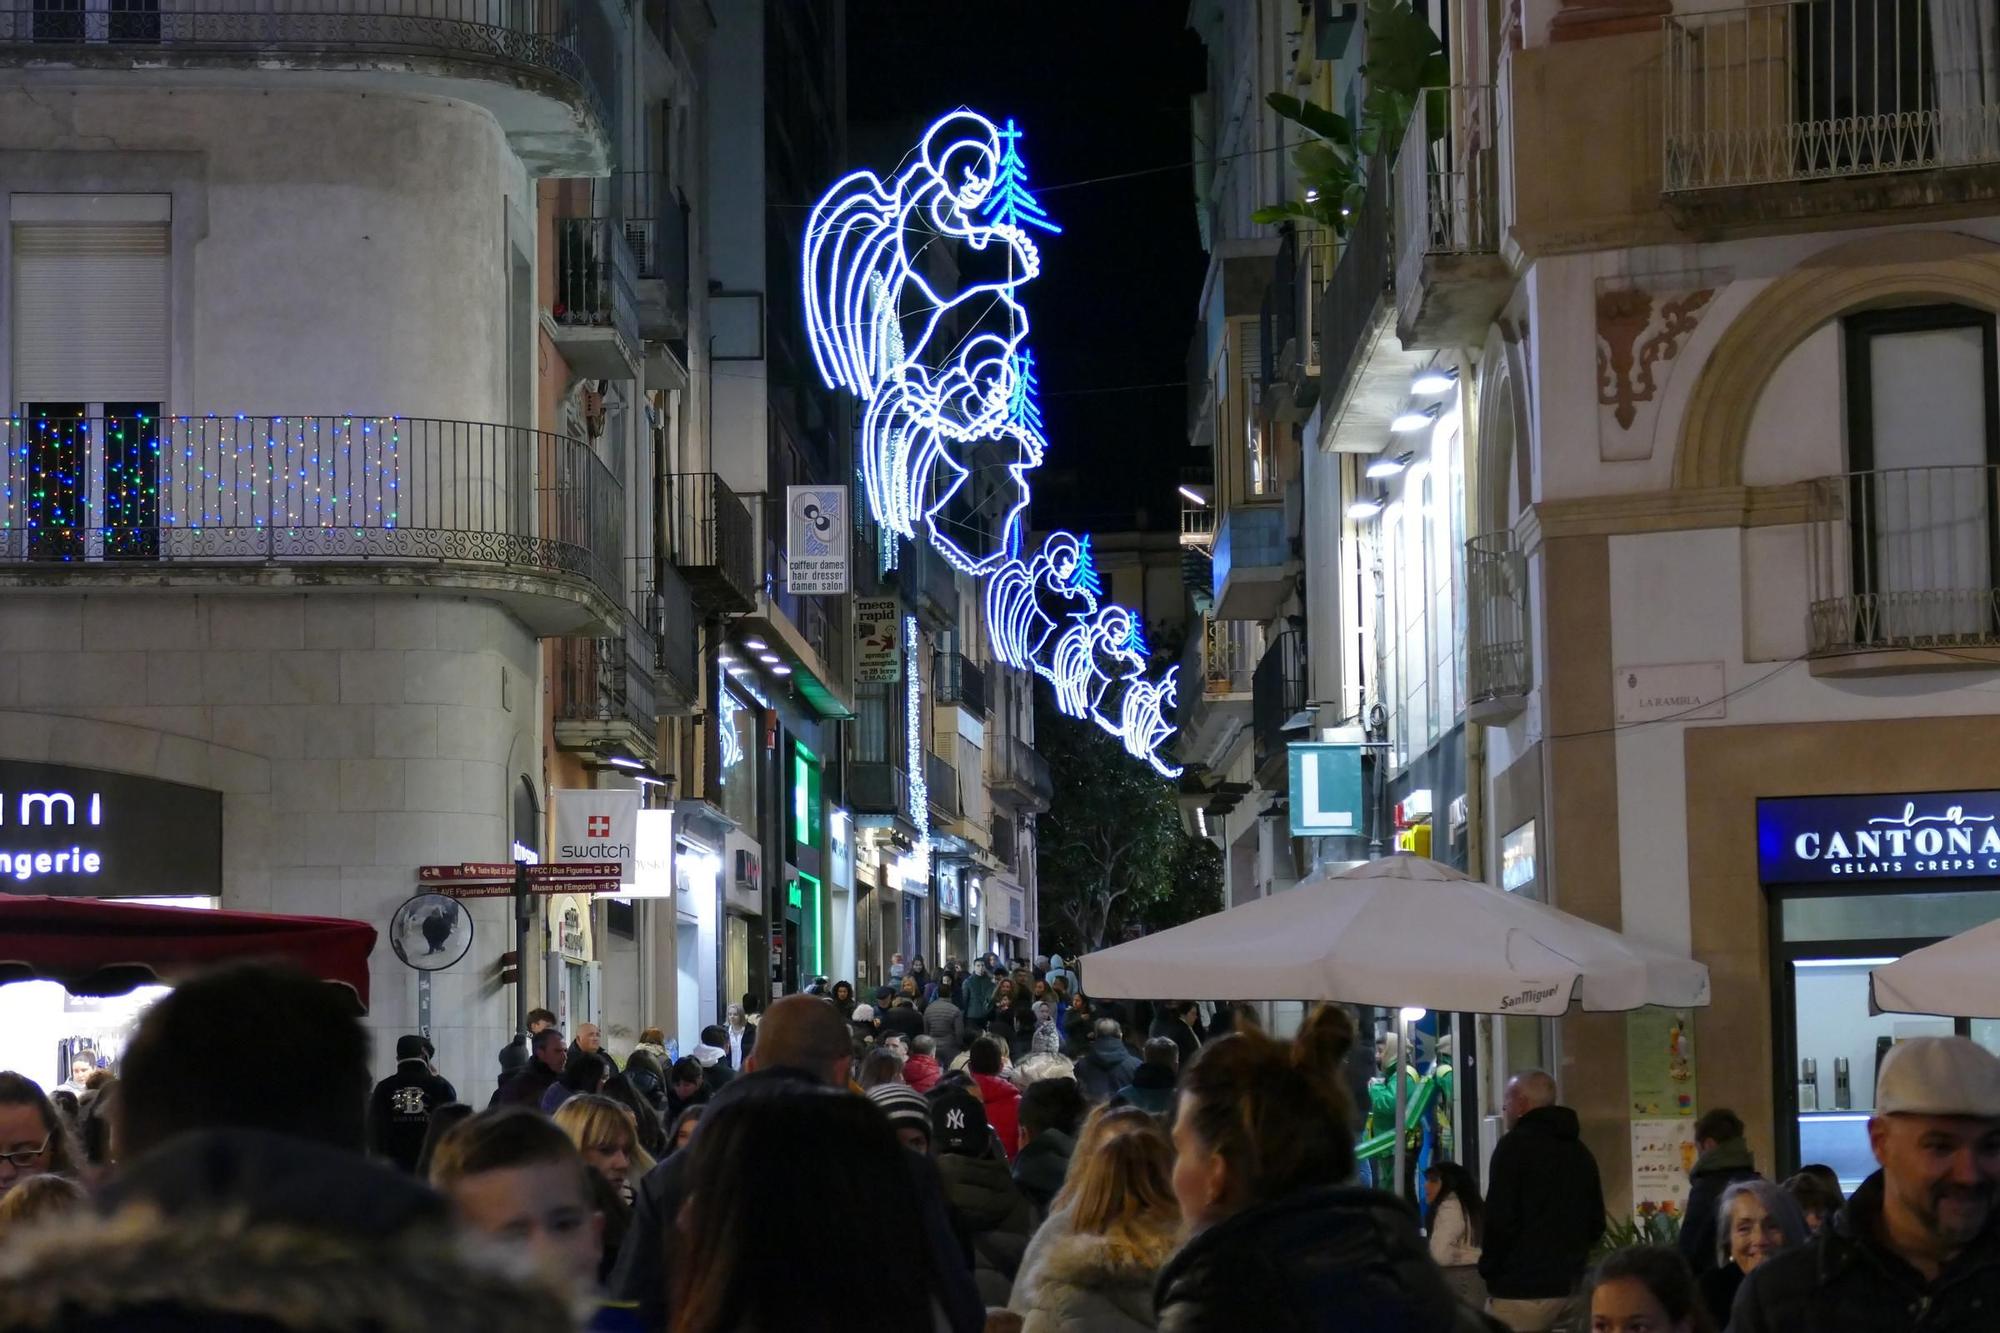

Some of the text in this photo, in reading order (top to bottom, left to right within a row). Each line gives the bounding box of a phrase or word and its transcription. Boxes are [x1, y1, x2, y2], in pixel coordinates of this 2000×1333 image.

[790, 560, 844, 570] coiffeur dames
[792, 571, 843, 580] hair dresser
[791, 581, 843, 591] damen salon
[859, 601, 895, 610] meca
[860, 610, 895, 622] rapid
[1655, 696, 1701, 706] RAMBLA
[561, 843, 630, 859] swatch
[566, 867, 593, 875] Figueres
[1831, 862, 1903, 874] GELATS
[1914, 859, 1976, 872] CREPS
[440, 887, 455, 896] AVE
